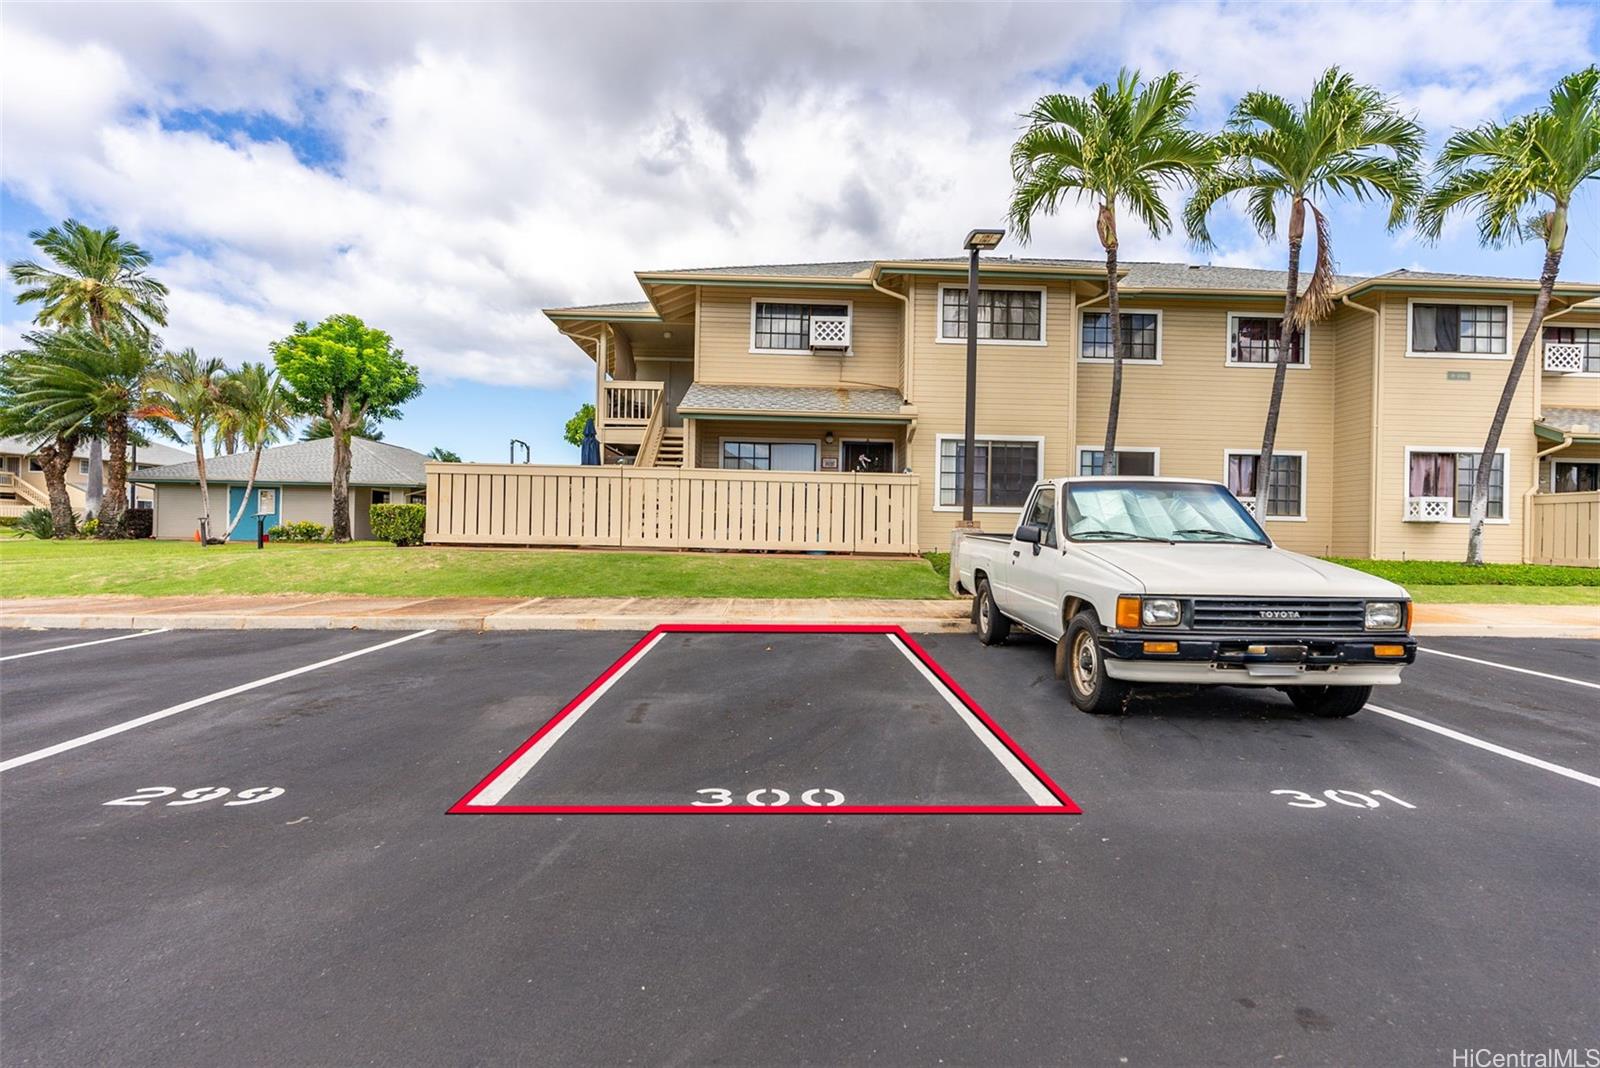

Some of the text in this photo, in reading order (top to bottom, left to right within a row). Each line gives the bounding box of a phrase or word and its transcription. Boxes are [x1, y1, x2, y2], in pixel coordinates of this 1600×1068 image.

[1259, 610, 1301, 618] TOYOTA
[102, 786, 286, 806] 299
[691, 787, 846, 807] 300
[1270, 789, 1417, 809] 301
